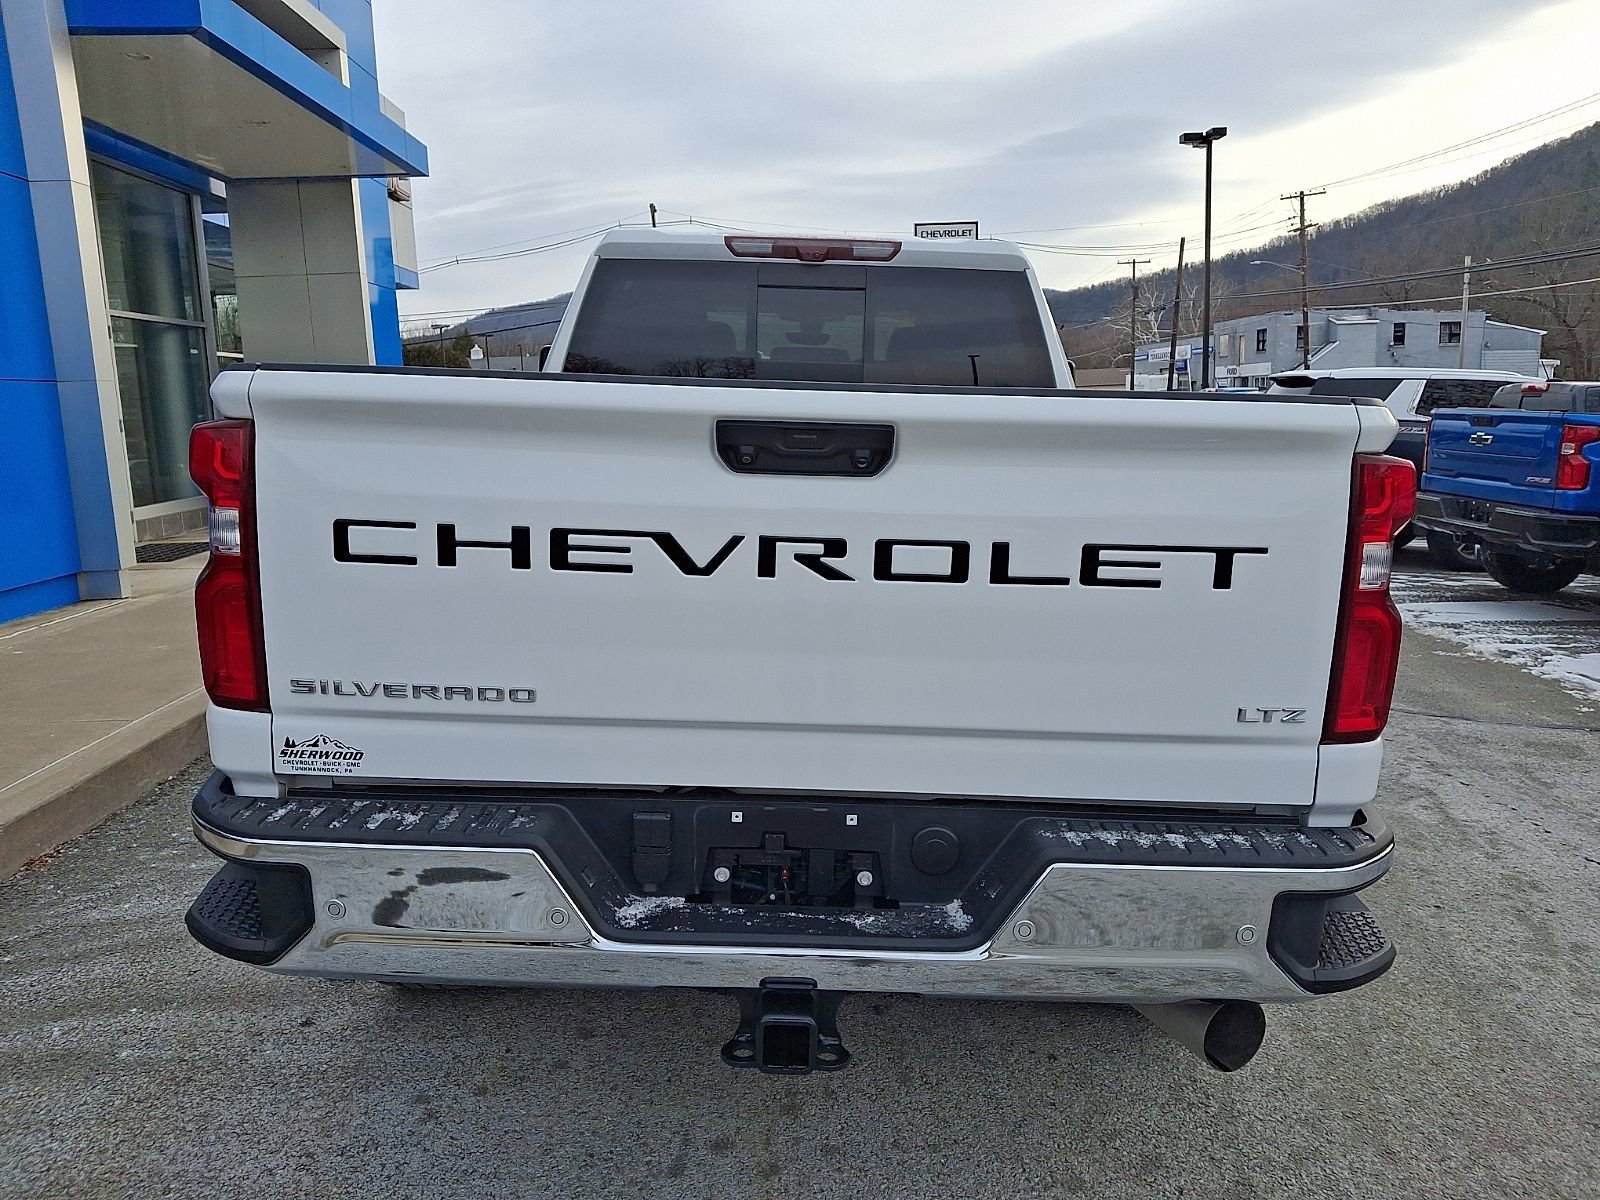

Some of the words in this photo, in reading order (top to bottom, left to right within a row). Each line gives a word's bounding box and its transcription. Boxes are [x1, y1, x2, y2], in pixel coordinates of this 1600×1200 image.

[920, 229, 973, 239] CHEVROLET
[332, 518, 1269, 589] CHEVROLET
[290, 678, 537, 703] SILVERADO
[1236, 706, 1307, 724] LTZ
[278, 748, 365, 761] SHERWOOD
[282, 759, 319, 767] CHEVROLET
